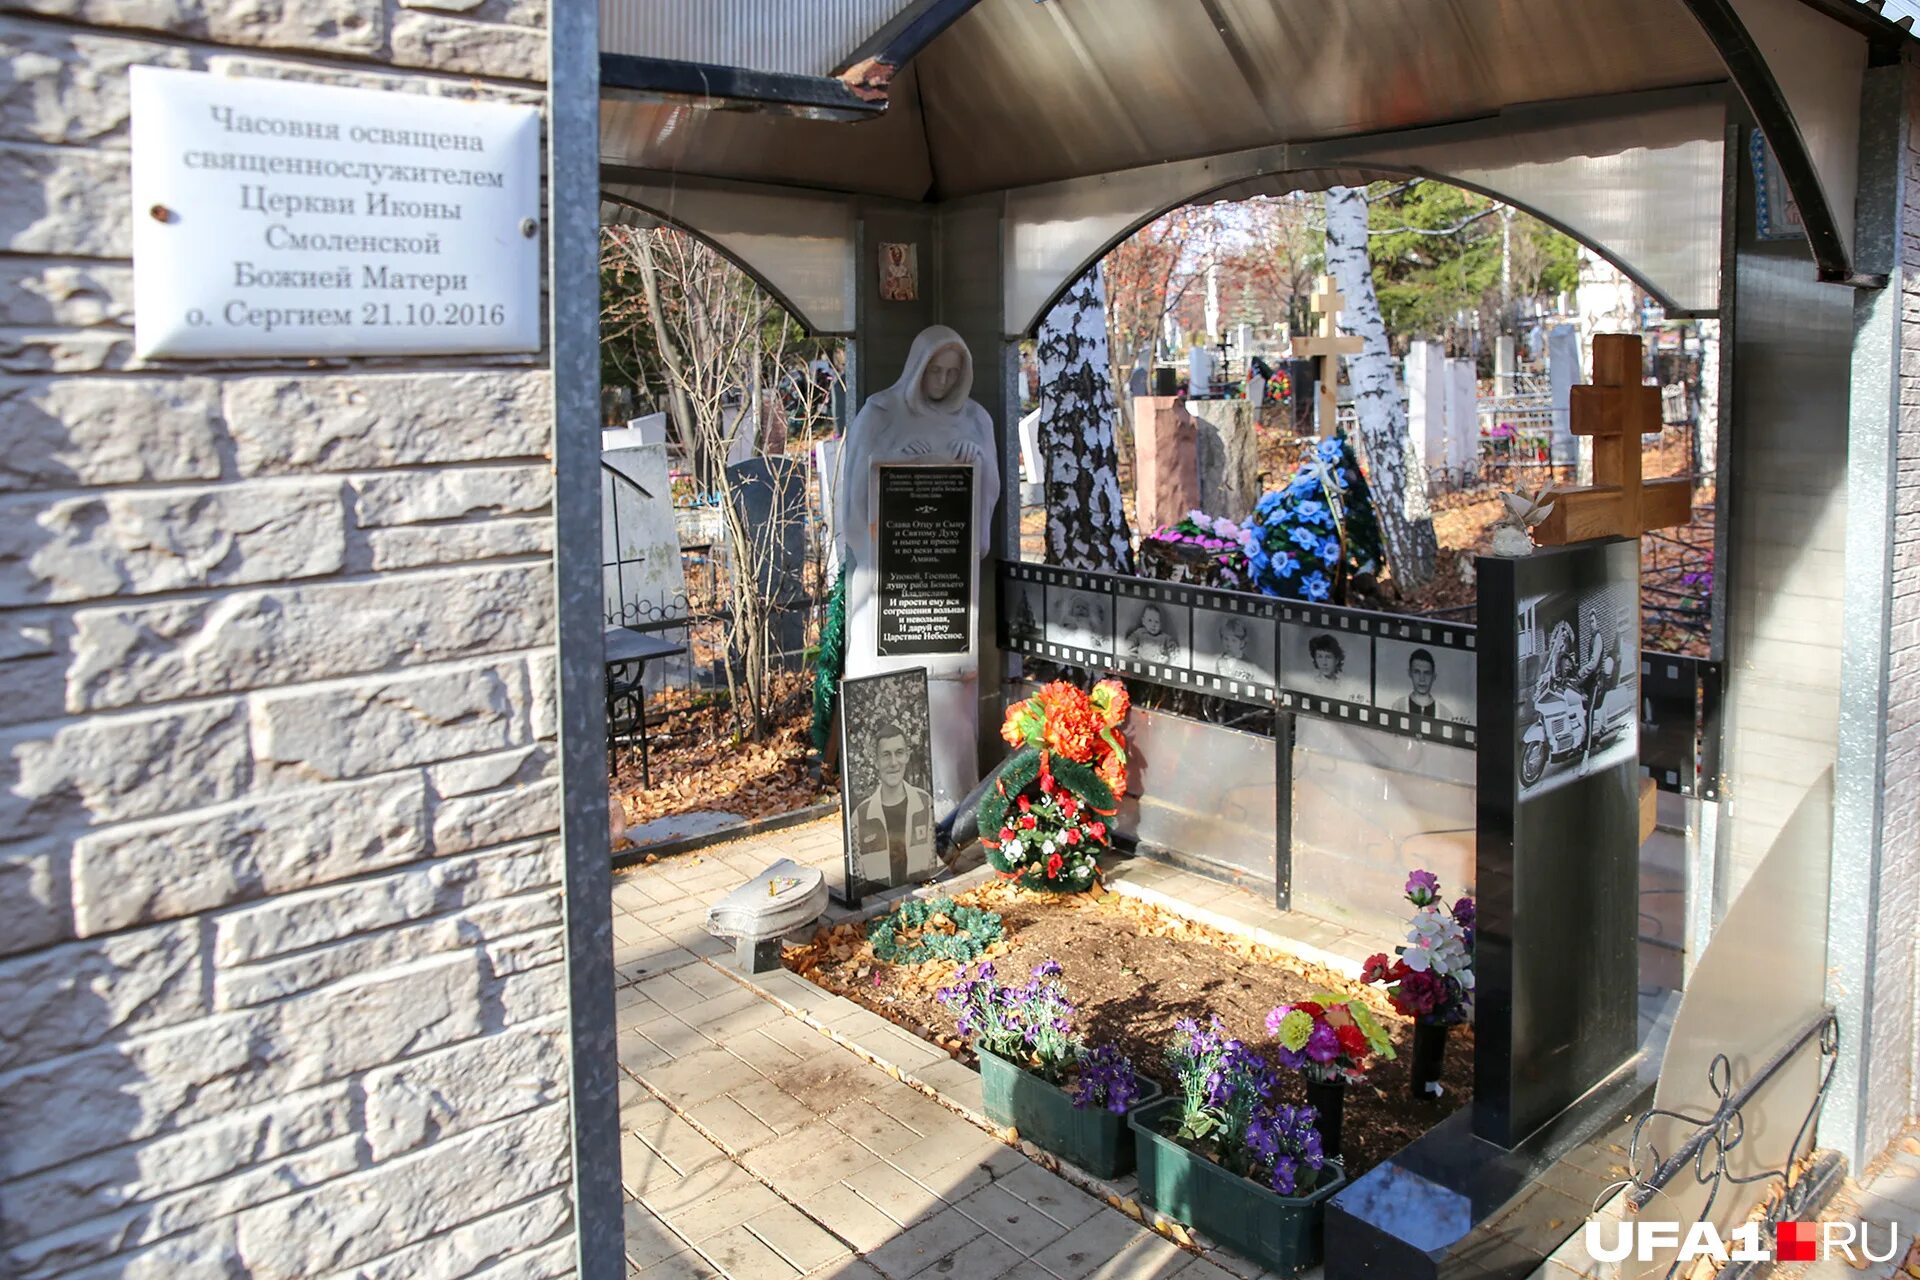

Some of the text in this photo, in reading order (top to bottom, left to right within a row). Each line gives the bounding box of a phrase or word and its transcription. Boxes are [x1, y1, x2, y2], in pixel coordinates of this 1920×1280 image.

[209, 104, 484, 153] Часовня освящена
[183, 149, 505, 189] священнослужителем
[239, 184, 462, 221] Церкви Иконы
[265, 224, 441, 256] Смоленской
[233, 261, 468, 296] Божией Матери
[185, 300, 505, 332] о. Сергием 21.10.2016
[886, 520, 911, 529] Слава
[912, 520, 933, 530] Отцу
[943, 520, 966, 530] Сыну
[902, 529, 937, 538] Святому
[938, 529, 959, 538] Духу
[930, 539, 960, 547] присно
[885, 582, 908, 591] душу
[909, 581, 929, 590] раба
[898, 599, 928, 608] прости
[929, 599, 945, 607] ему
[882, 607, 966, 617] согрешения вольная
[906, 616, 951, 624] невольная,
[907, 624, 933, 634] даруй
[933, 625, 950, 633] ему
[883, 631, 965, 643] Царствие Небесное.
